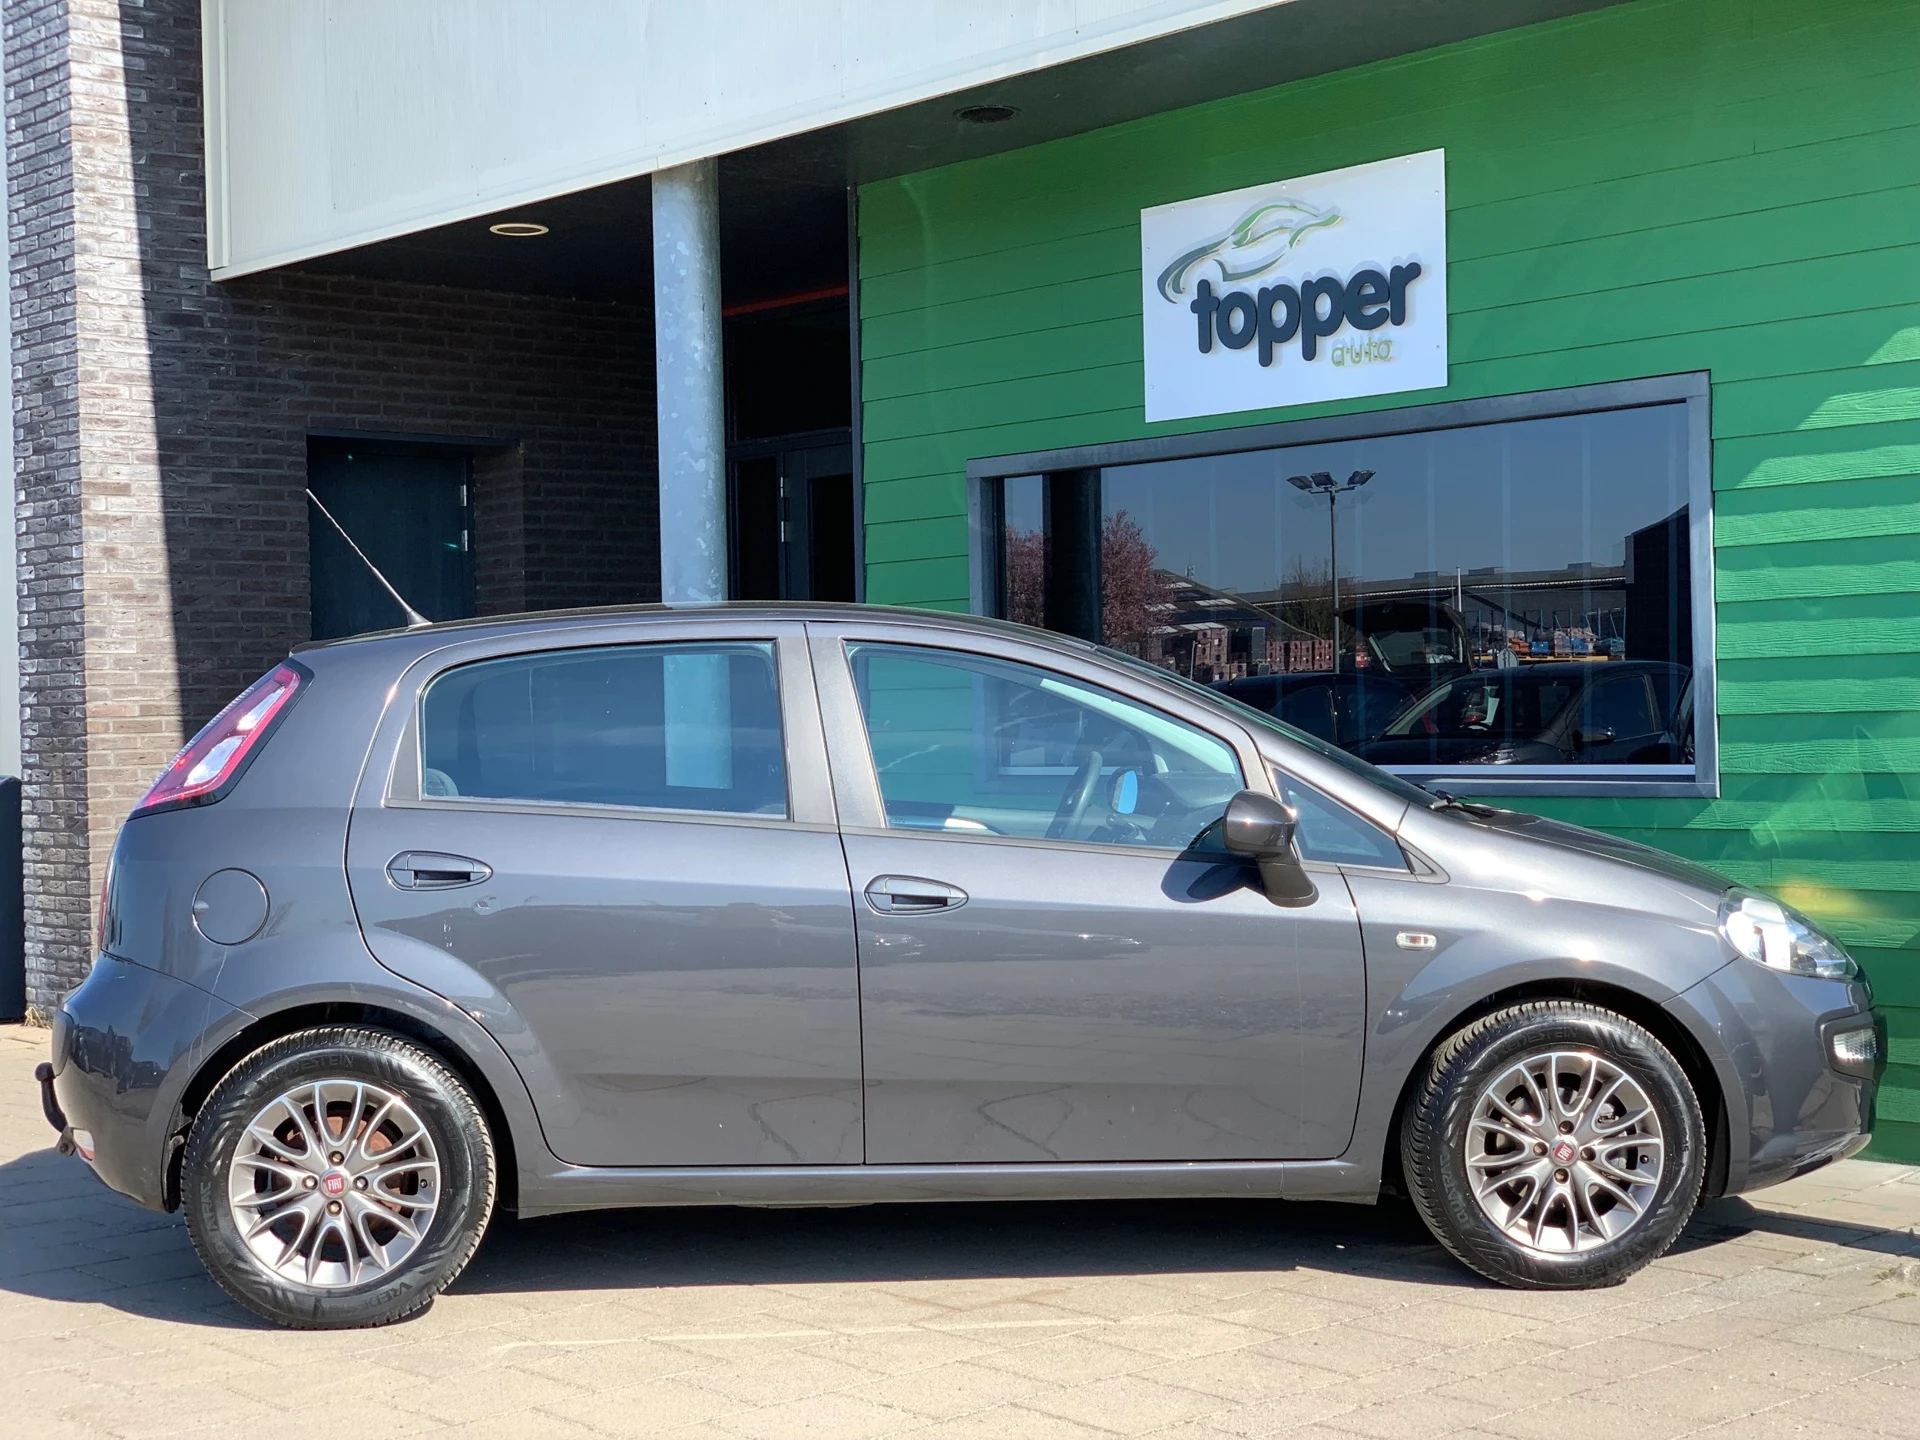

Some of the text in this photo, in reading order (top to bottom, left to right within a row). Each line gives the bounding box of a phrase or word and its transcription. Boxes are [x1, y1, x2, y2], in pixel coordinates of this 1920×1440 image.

[1191, 262, 1422, 367] topper
[1331, 337, 1392, 367] auto
[1557, 1144, 1573, 1161] FIAT
[327, 1177, 343, 1191] FIAT
